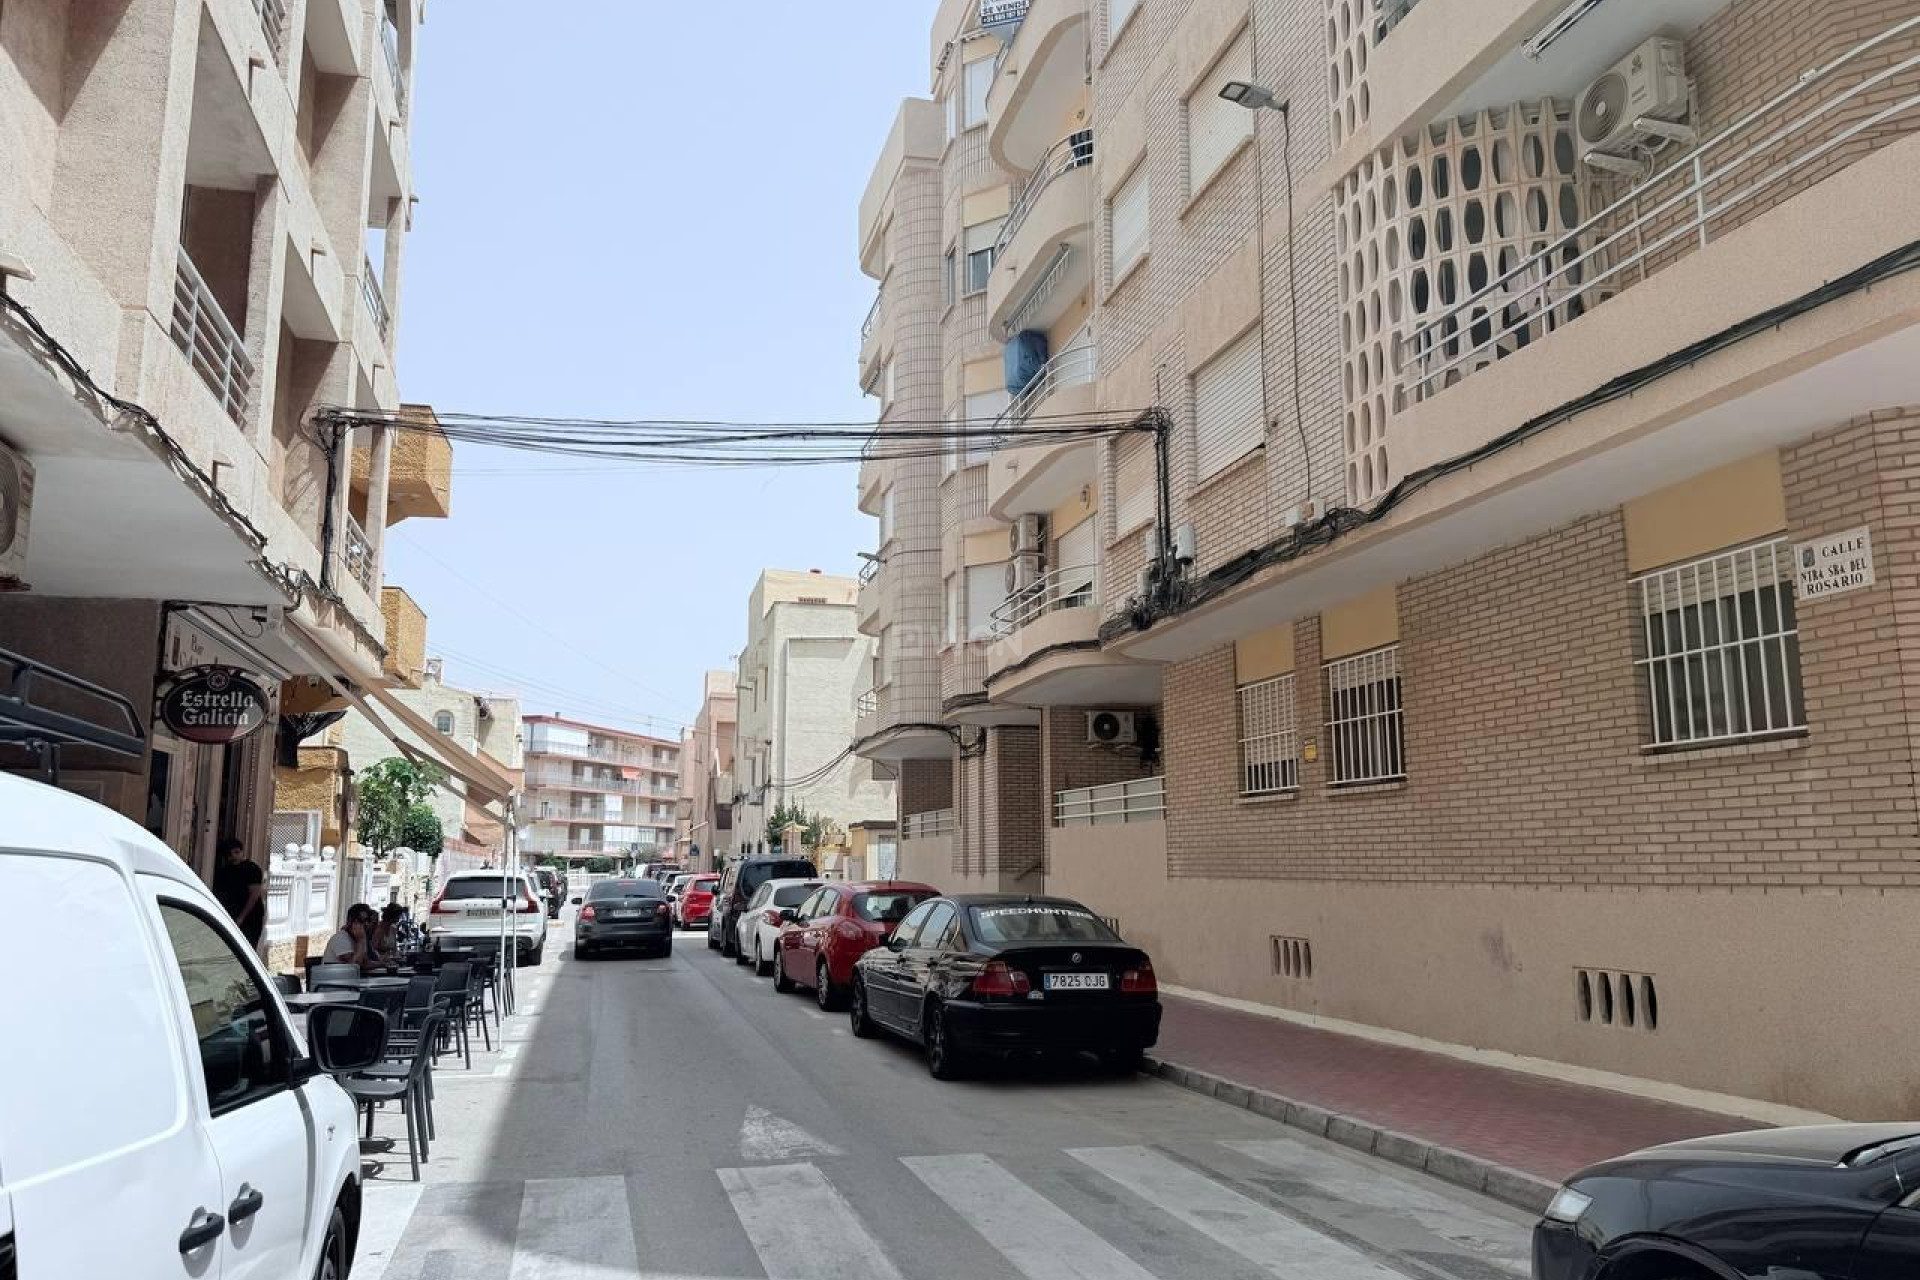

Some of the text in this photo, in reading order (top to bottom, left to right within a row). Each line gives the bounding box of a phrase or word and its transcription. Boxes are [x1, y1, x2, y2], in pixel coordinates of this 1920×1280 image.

[983, 6, 994, 14] SE
[1822, 537, 1863, 558] CALLE
[1801, 557, 1867, 582] NTRA SRA DEL
[1806, 573, 1863, 595] ROSARIO
[180, 690, 254, 708] Estrella
[182, 708, 249, 725] Galicia
[1052, 975, 1105, 987] 7825 CJG
